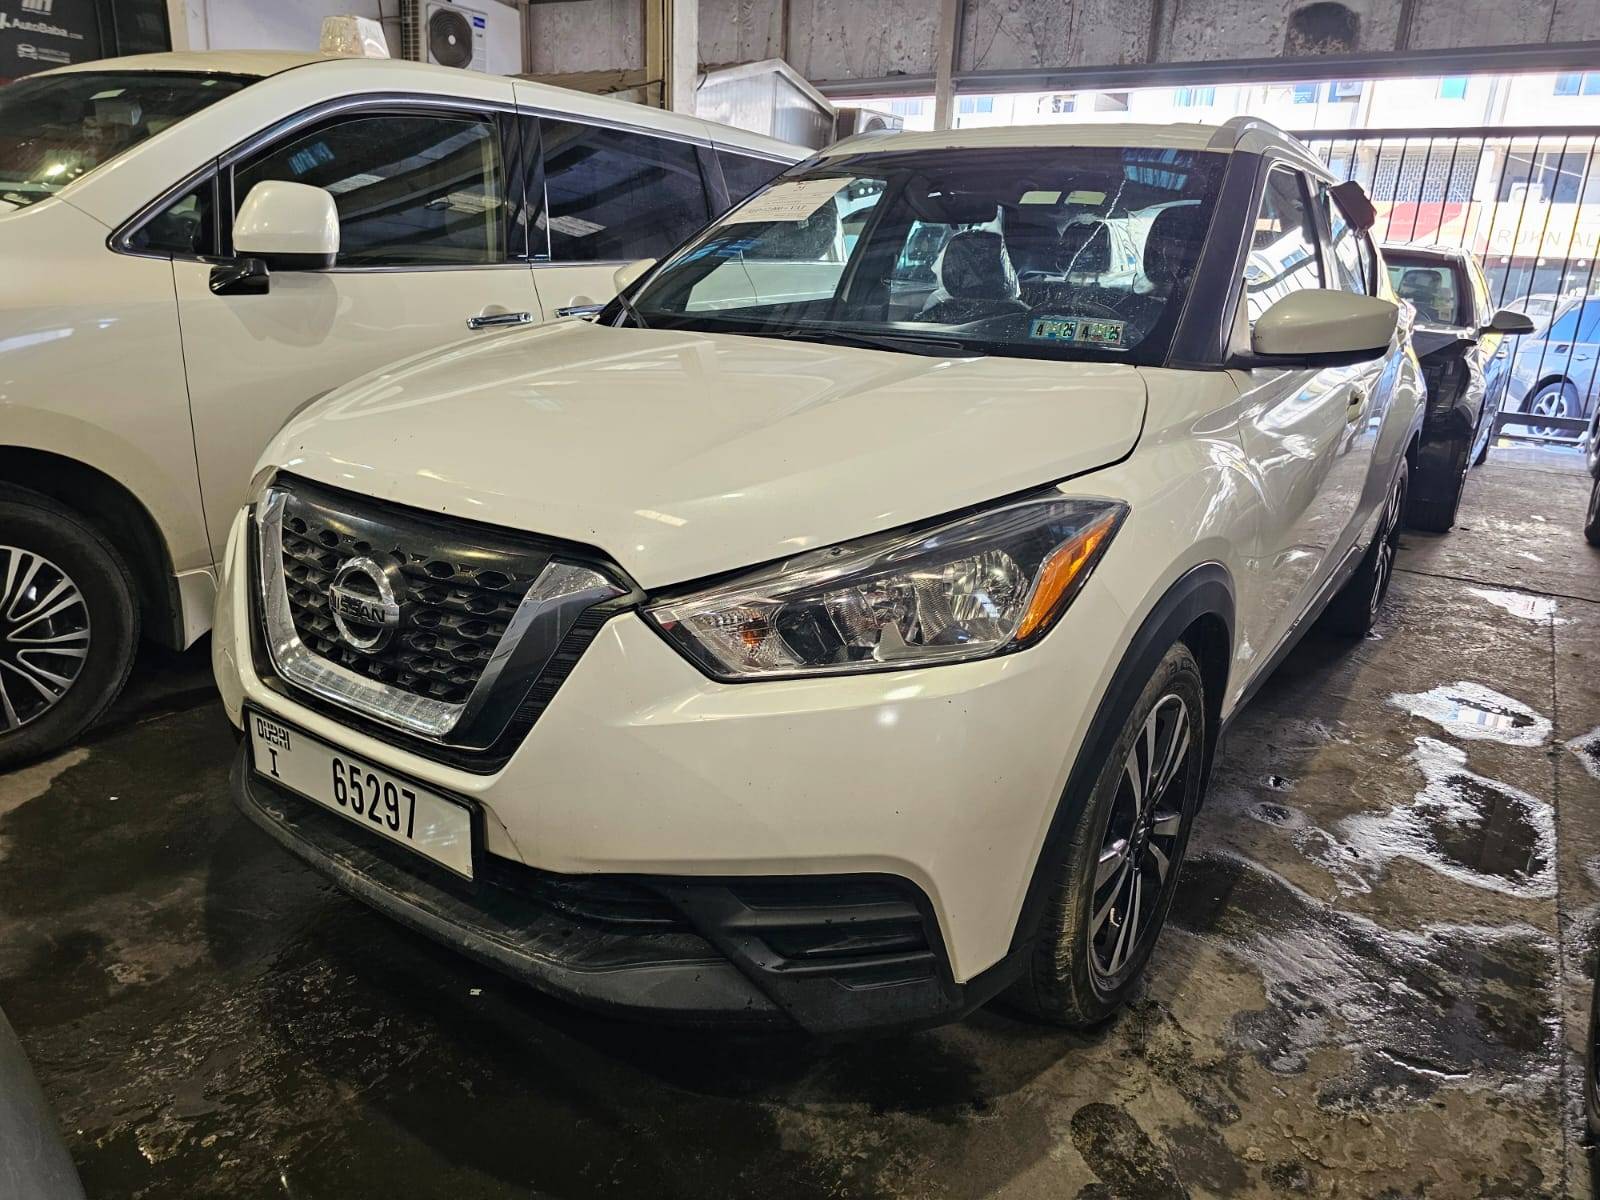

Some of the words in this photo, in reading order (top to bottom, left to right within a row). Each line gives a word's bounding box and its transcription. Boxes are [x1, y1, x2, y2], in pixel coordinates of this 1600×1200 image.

[1035, 323, 1045, 337] 4
[1062, 322, 1075, 337] 25
[1081, 325, 1090, 339] 4
[1108, 325, 1121, 341] 25
[330, 588, 386, 623] NISSAN
[268, 747, 280, 778] I
[332, 757, 417, 840] 65297
